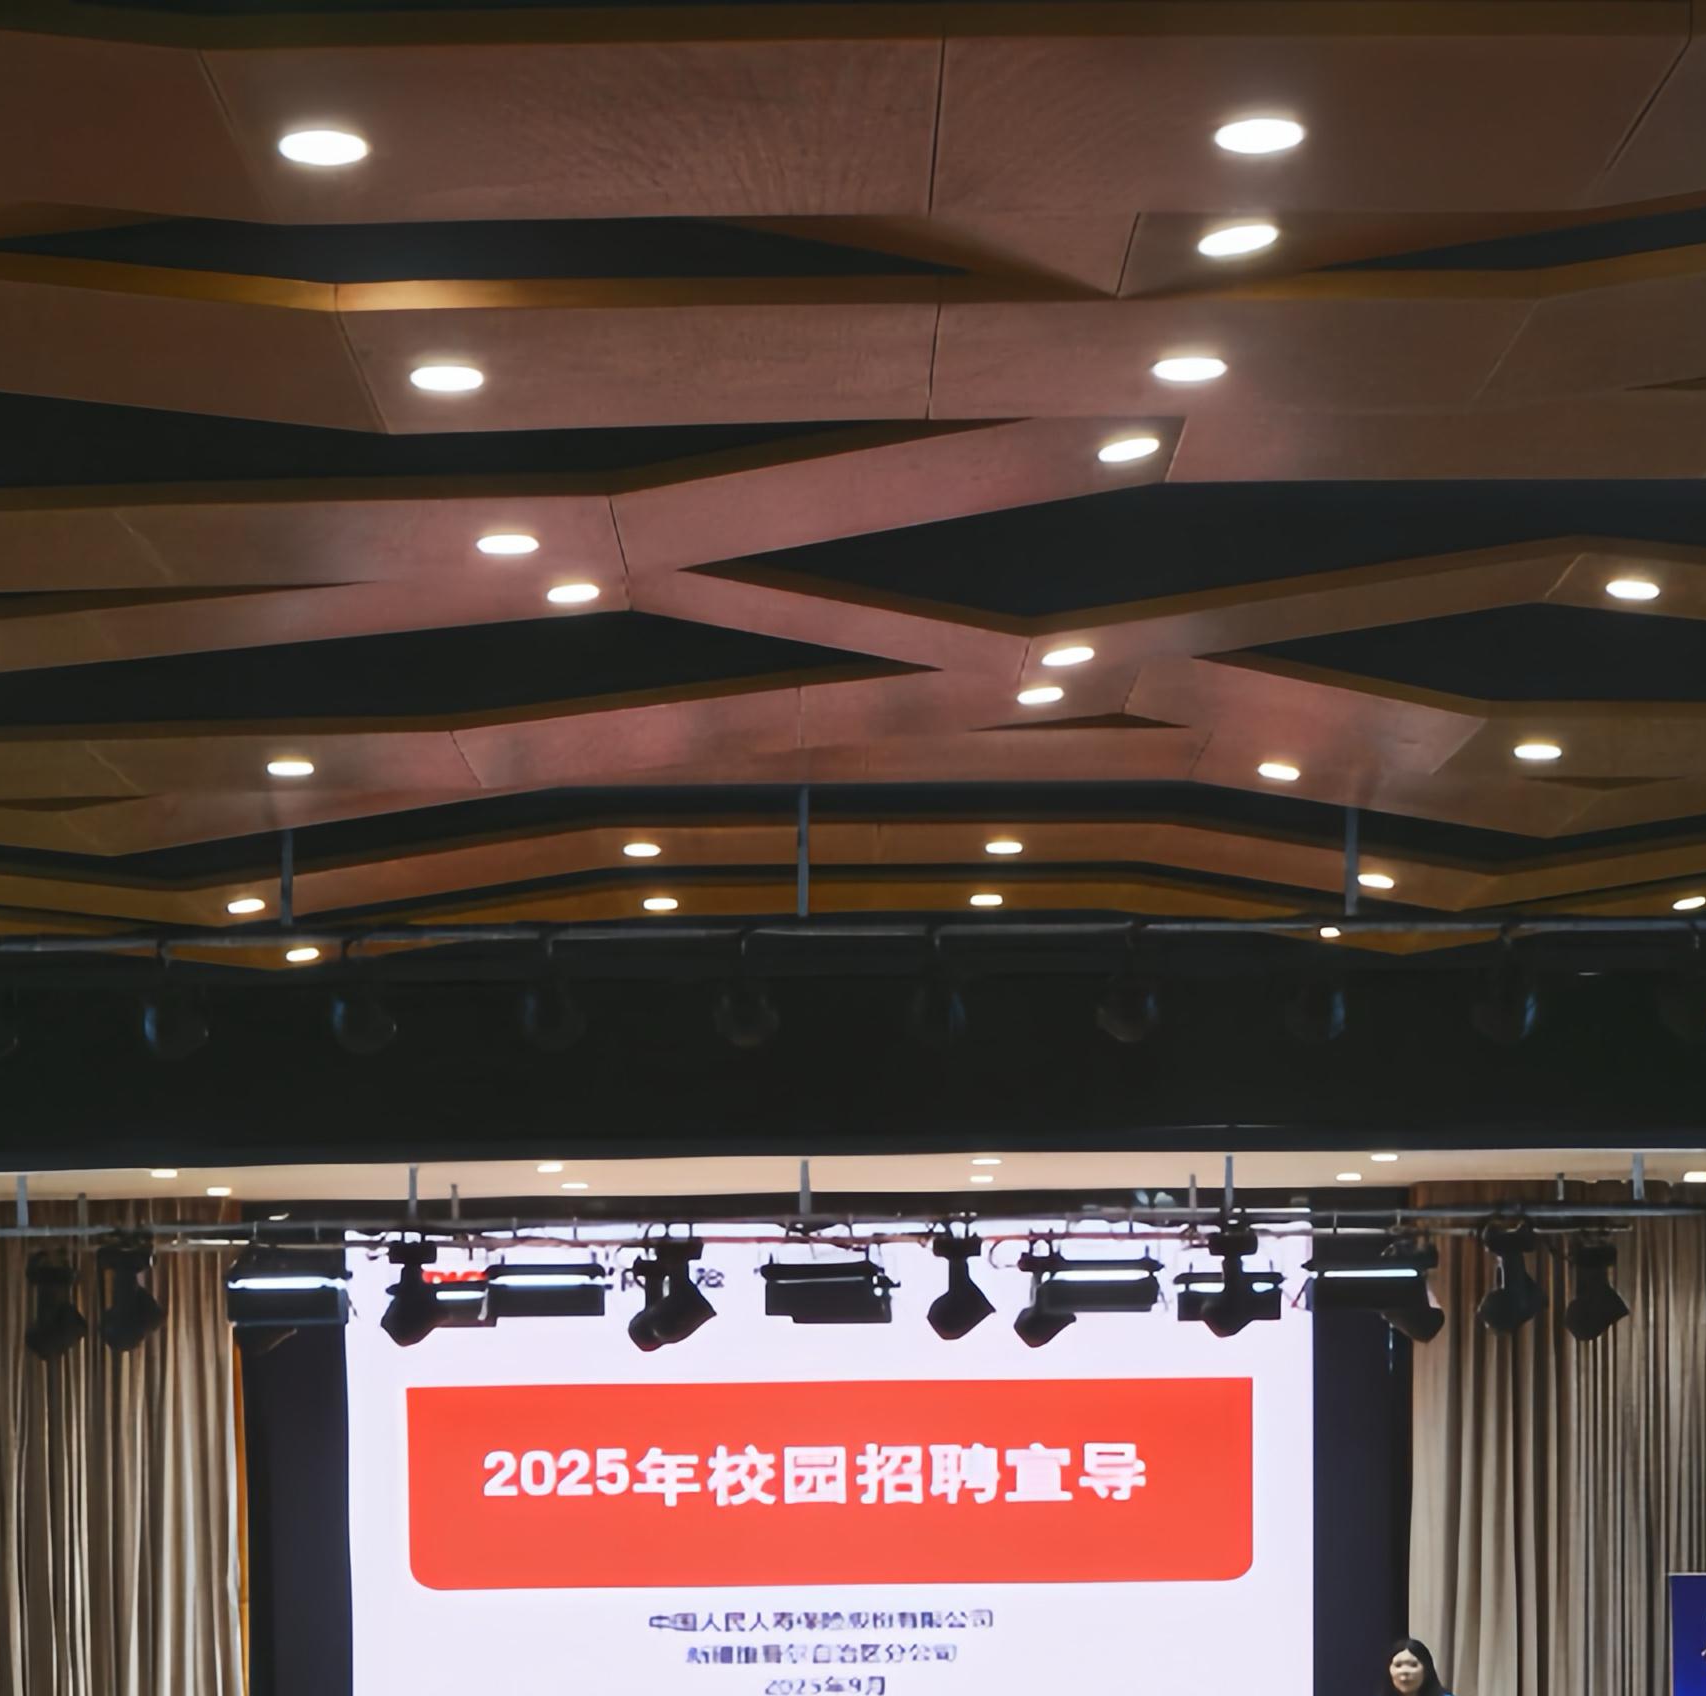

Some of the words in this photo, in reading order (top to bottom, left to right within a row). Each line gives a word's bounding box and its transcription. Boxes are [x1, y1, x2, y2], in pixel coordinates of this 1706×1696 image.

[482, 1441, 1147, 1507] 2025年校园招聘宣导
[764, 1674, 887, 1696] 2025年9月
